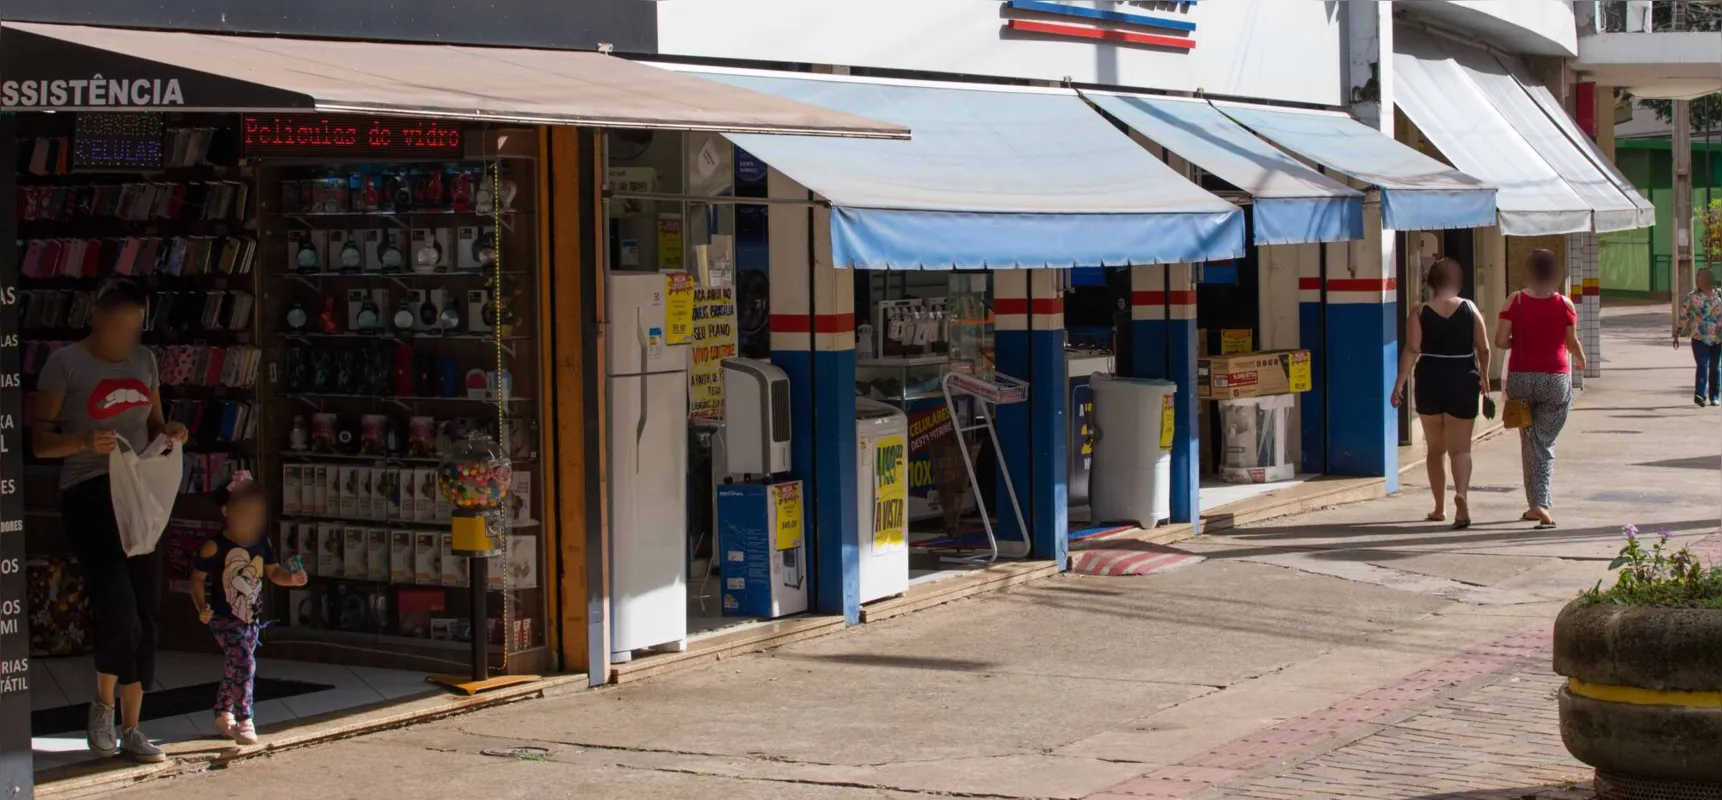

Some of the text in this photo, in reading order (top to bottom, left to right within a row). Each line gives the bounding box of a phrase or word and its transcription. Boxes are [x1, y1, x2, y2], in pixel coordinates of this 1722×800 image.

[1, 73, 184, 106] SSISTÊNCIA
[369, 121, 391, 145] de
[403, 121, 458, 147] vidro
[80, 139, 159, 160] CELULAR
[693, 323, 731, 340] SEU PLANO
[910, 407, 951, 438] CELULARES
[883, 498, 904, 531] VISTA
[0, 519, 23, 533] DORES
[1, 558, 19, 574] OS
[1, 658, 28, 674] RIAS
